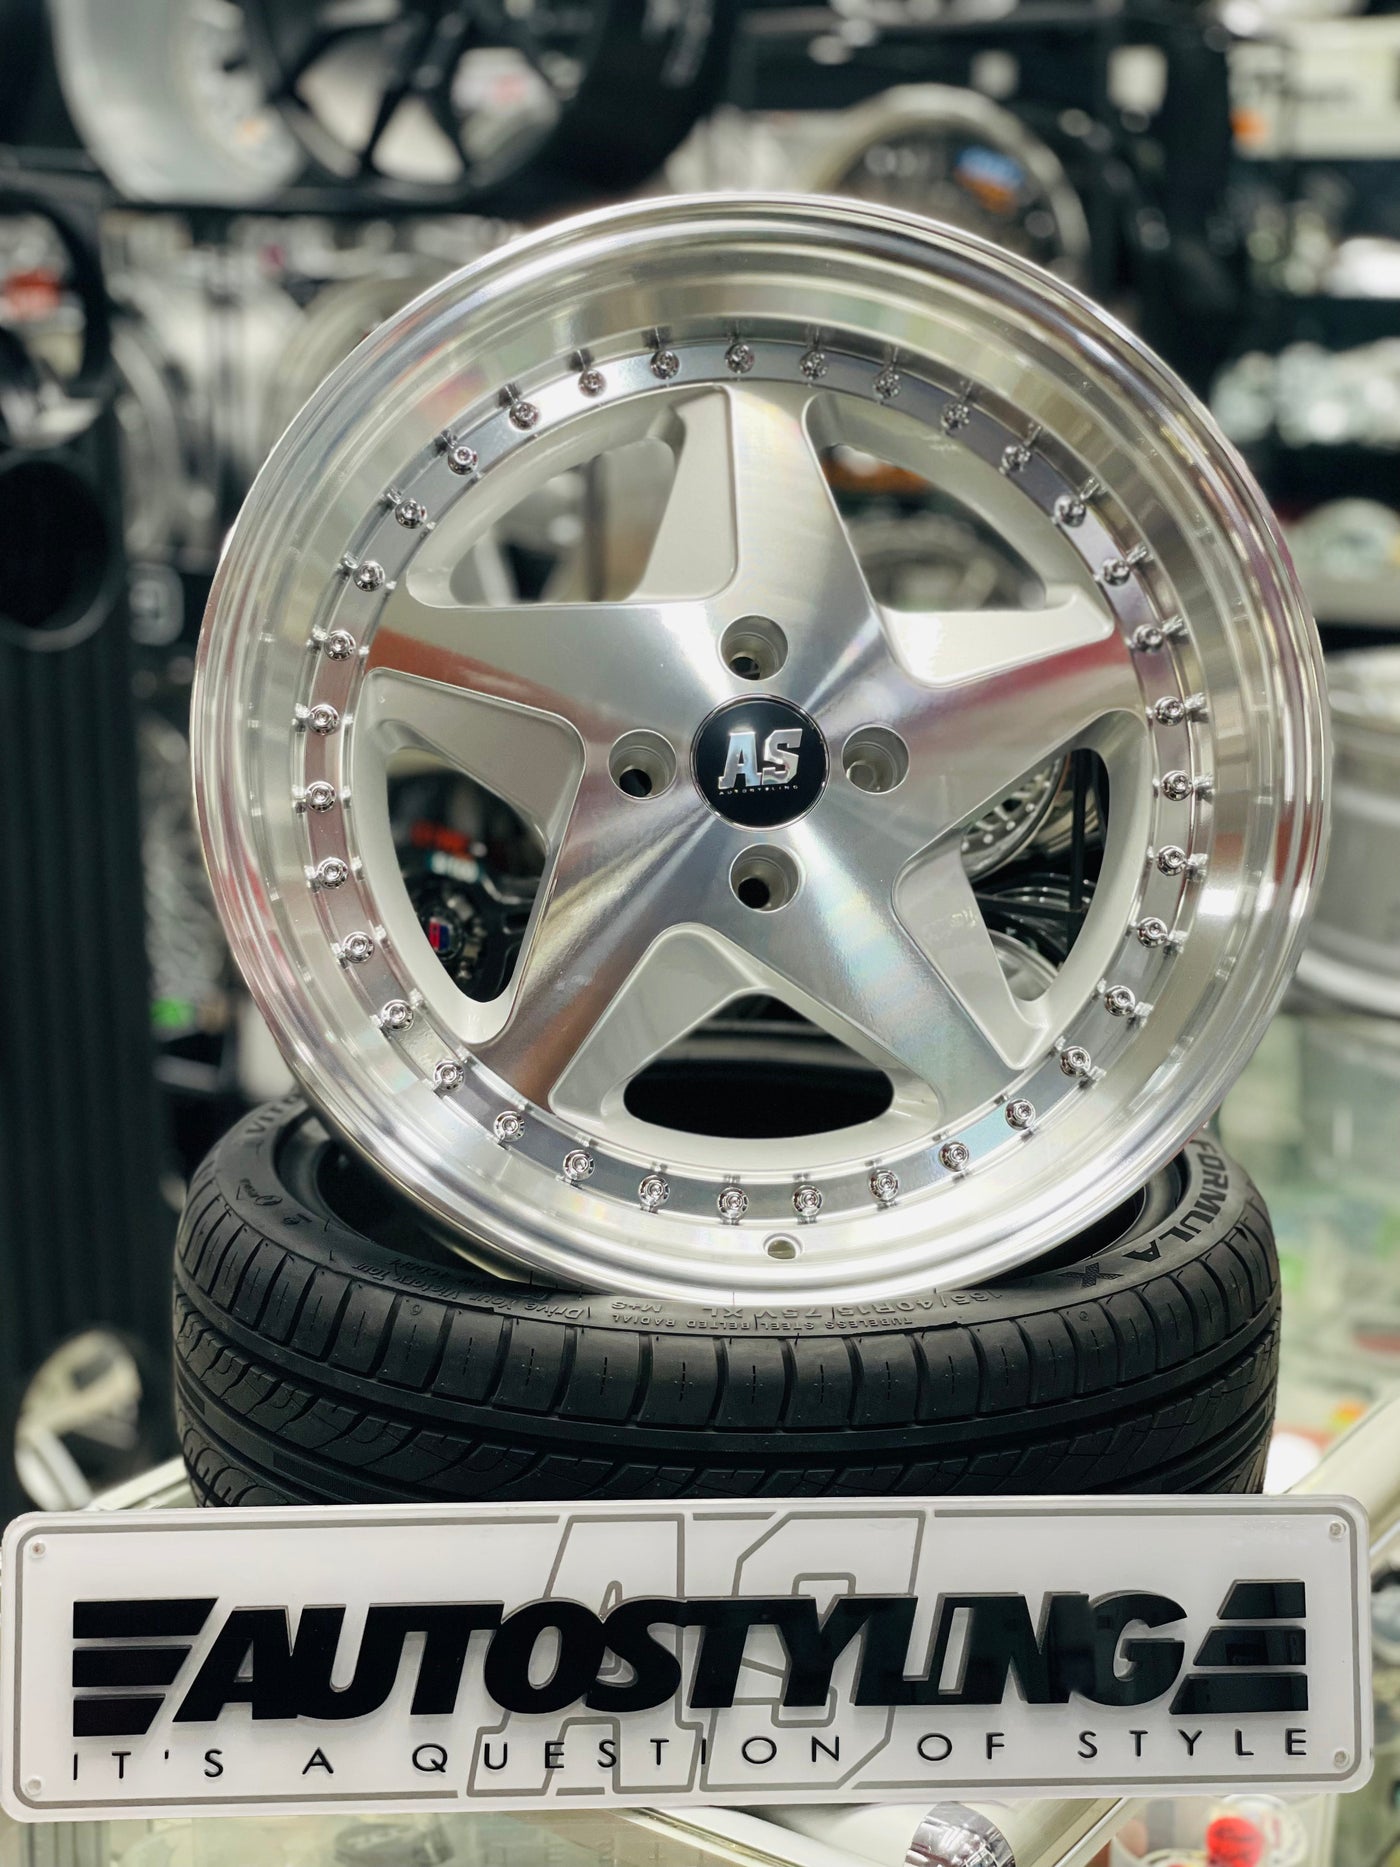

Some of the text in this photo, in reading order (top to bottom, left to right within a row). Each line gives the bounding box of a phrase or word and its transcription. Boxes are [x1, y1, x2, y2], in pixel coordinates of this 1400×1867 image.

[718, 728, 803, 790] AS
[1122, 1137, 1229, 1263] FORMULA
[471, 1294, 516, 1311] Your
[524, 1301, 585, 1319] Drive
[612, 1300, 663, 1313] M+S
[613, 1313, 913, 1331] TUBELESS STEEL BELTED RADIAL
[702, 1307, 744, 1319] XL
[172, 1590, 1187, 1722] AUTOSTYLING
[73, 1727, 1307, 1780] IT'S A QUESTION OF STYLE
